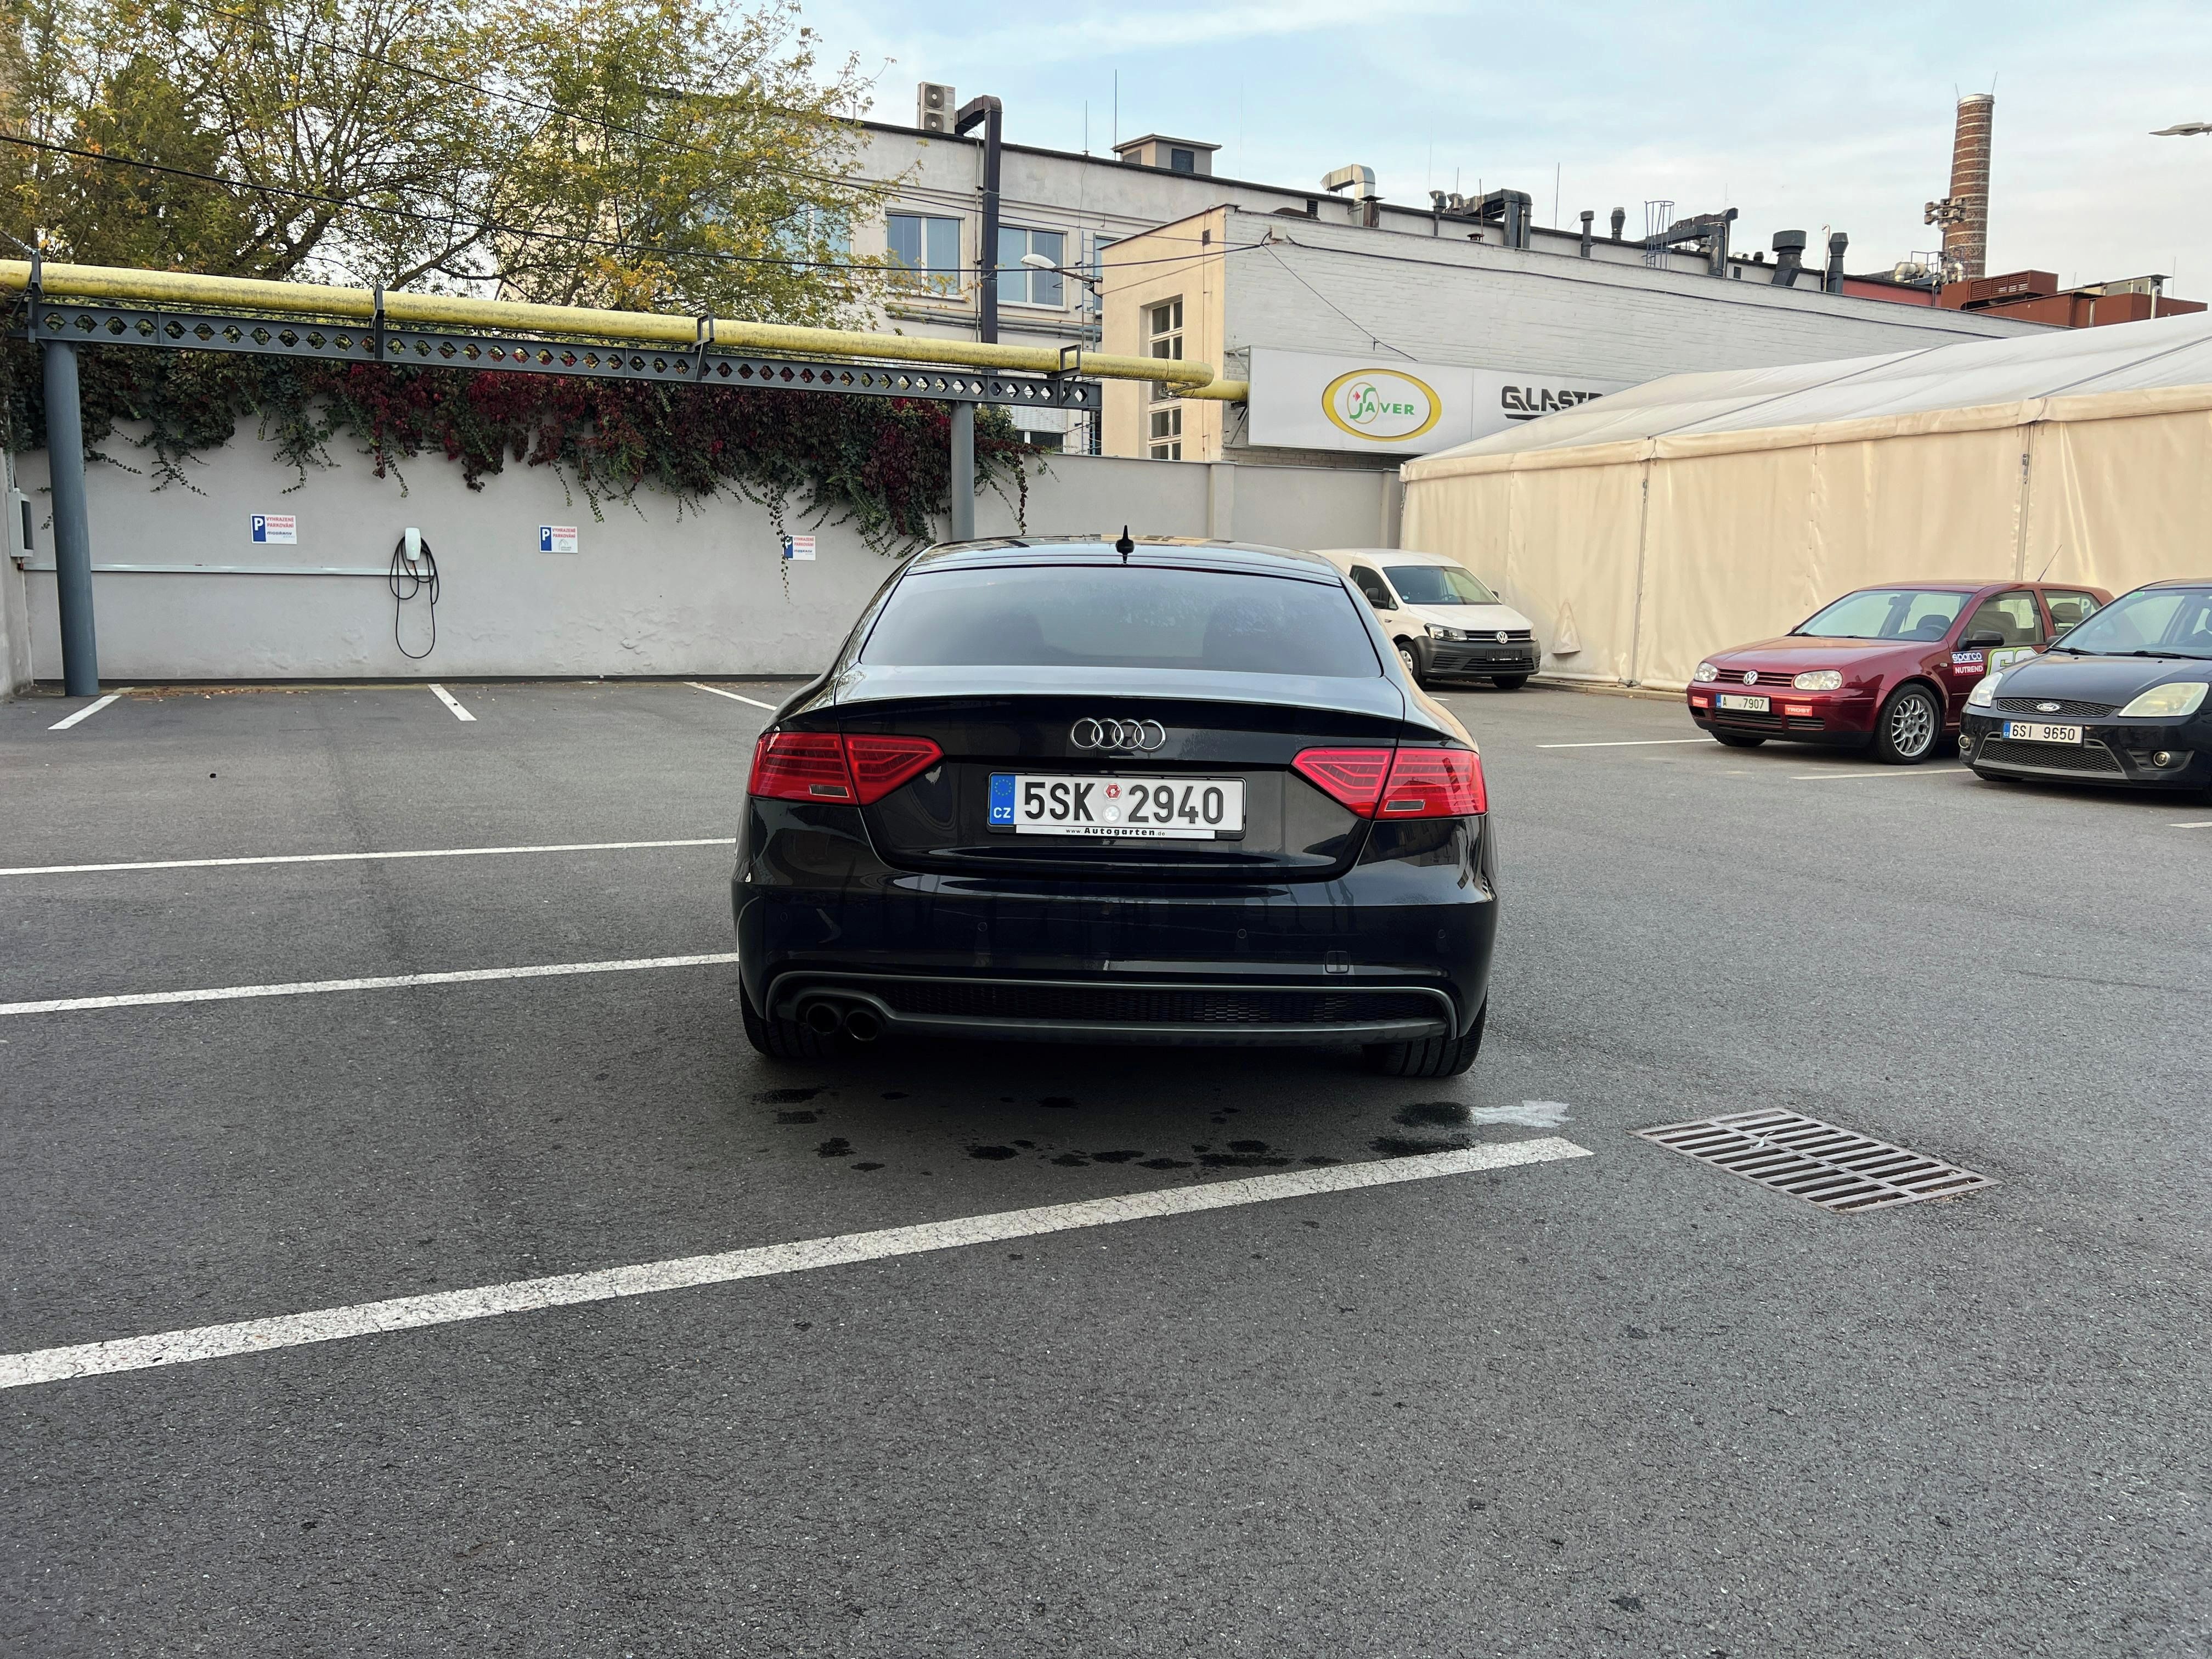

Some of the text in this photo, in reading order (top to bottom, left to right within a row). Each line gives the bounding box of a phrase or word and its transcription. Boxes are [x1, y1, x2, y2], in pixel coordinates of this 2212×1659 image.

[1350, 387, 1414, 419] SAVER
[254, 517, 264, 531] P
[542, 528, 550, 541] P
[1952, 652, 1982, 663] sparco
[1955, 665, 1983, 674] NUTREND
[1743, 698, 1764, 709] 7907
[2012, 724, 2075, 741] 6SI 9650
[1024, 782, 1224, 824] 5SK 2940
[994, 808, 1011, 819] CZ
